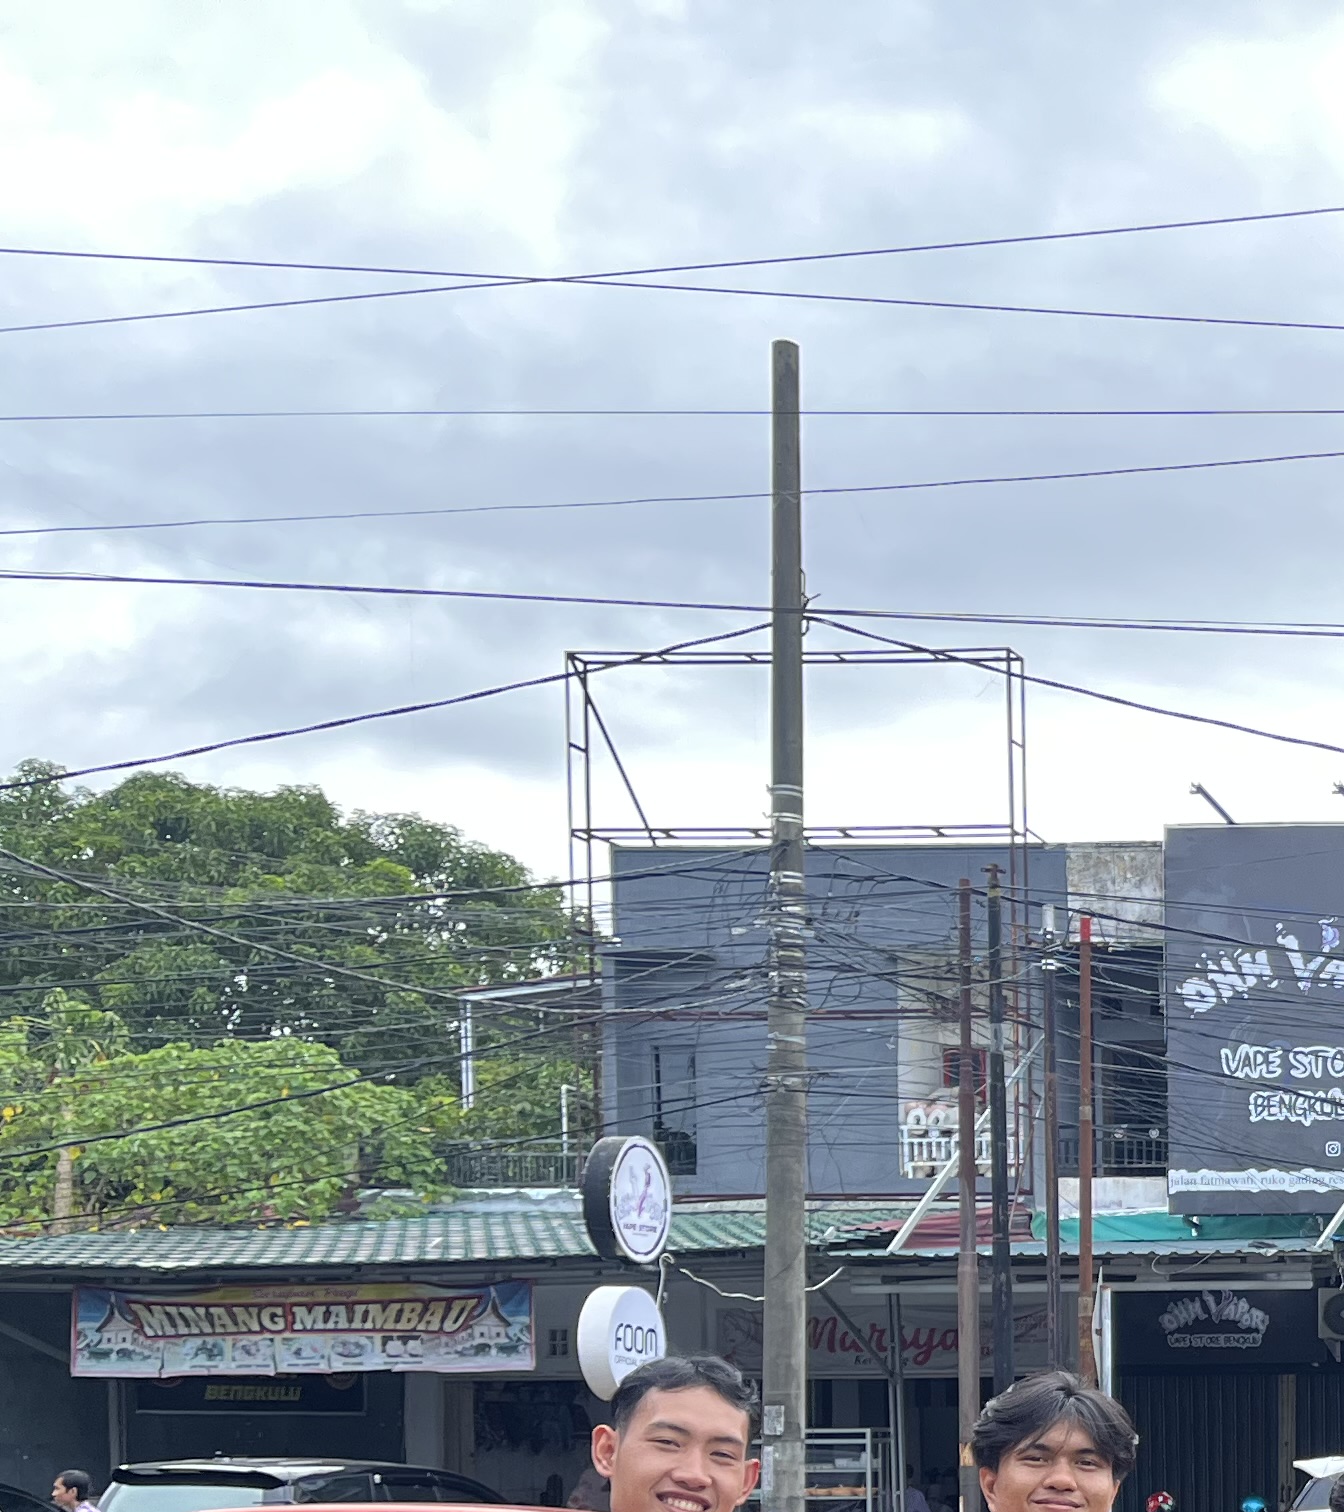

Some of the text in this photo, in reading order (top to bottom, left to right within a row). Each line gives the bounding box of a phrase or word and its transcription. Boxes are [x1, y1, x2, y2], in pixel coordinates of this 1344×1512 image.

[1176, 949, 1276, 1017] OHM
[1221, 1045, 1282, 1078] VAPE
[1170, 1175, 1197, 1188] jalan
[1260, 1174, 1286, 1185] ruko
[128, 1297, 479, 1338] MINANG MAIMBAU
[615, 1322, 658, 1358] FOOM
